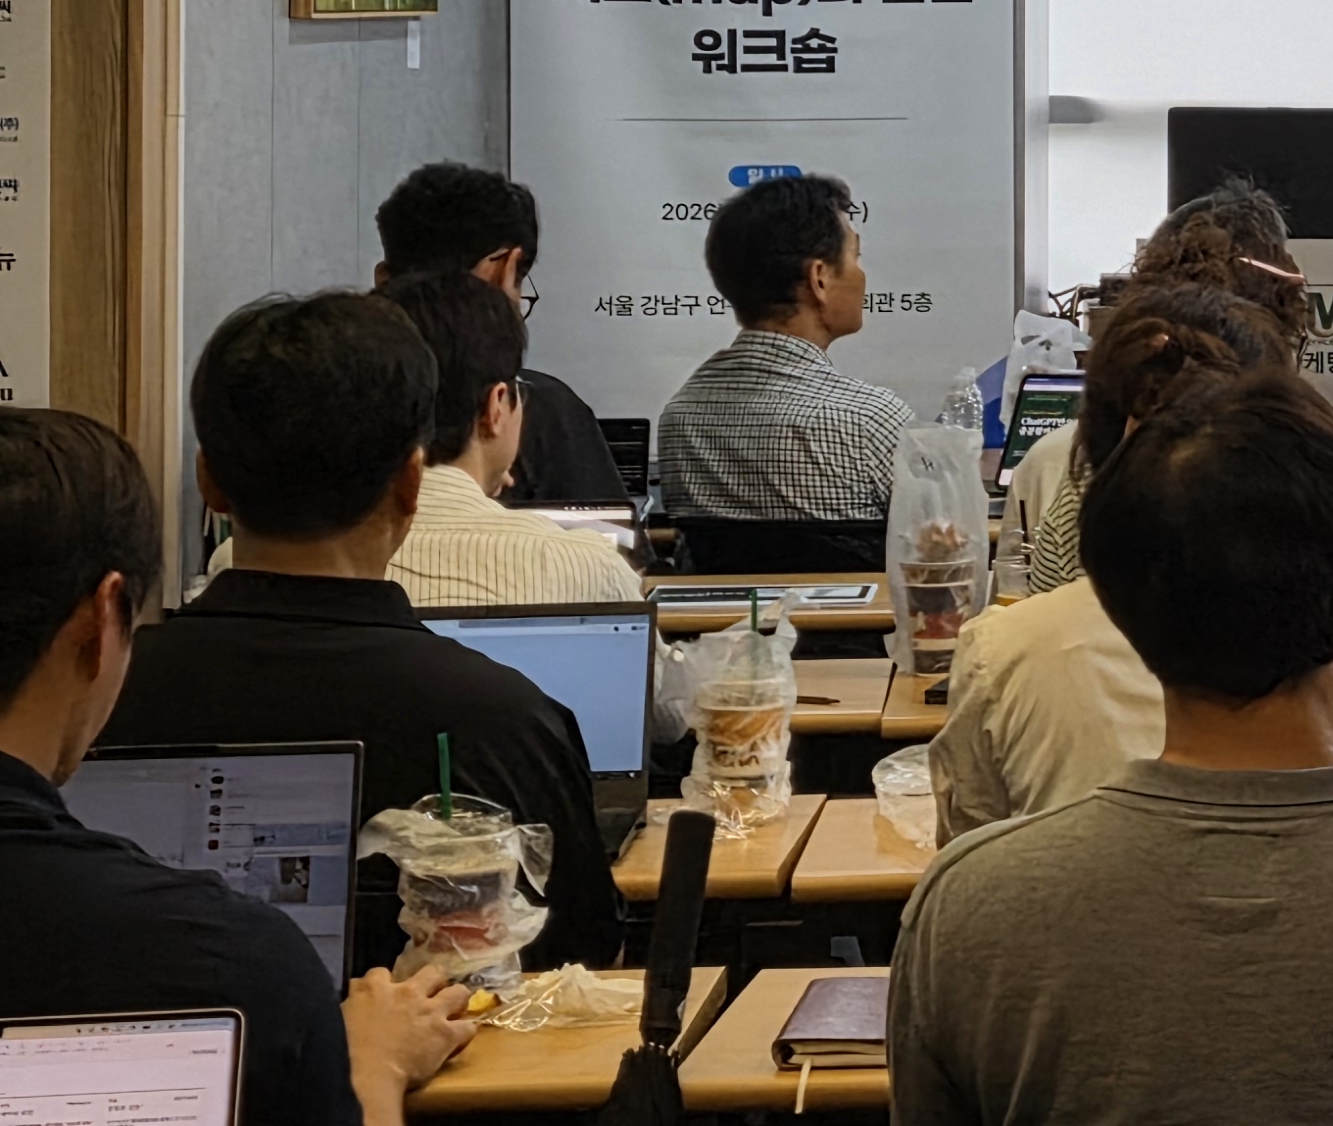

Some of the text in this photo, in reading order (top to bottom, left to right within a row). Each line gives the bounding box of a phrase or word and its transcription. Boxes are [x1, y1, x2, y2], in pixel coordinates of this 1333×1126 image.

[691, 27, 838, 75] 워크숍
[661, 203, 720, 222] 2026
[595, 295, 634, 316] 서울
[640, 295, 701, 316] 강남구
[900, 292, 933, 313] 5층
